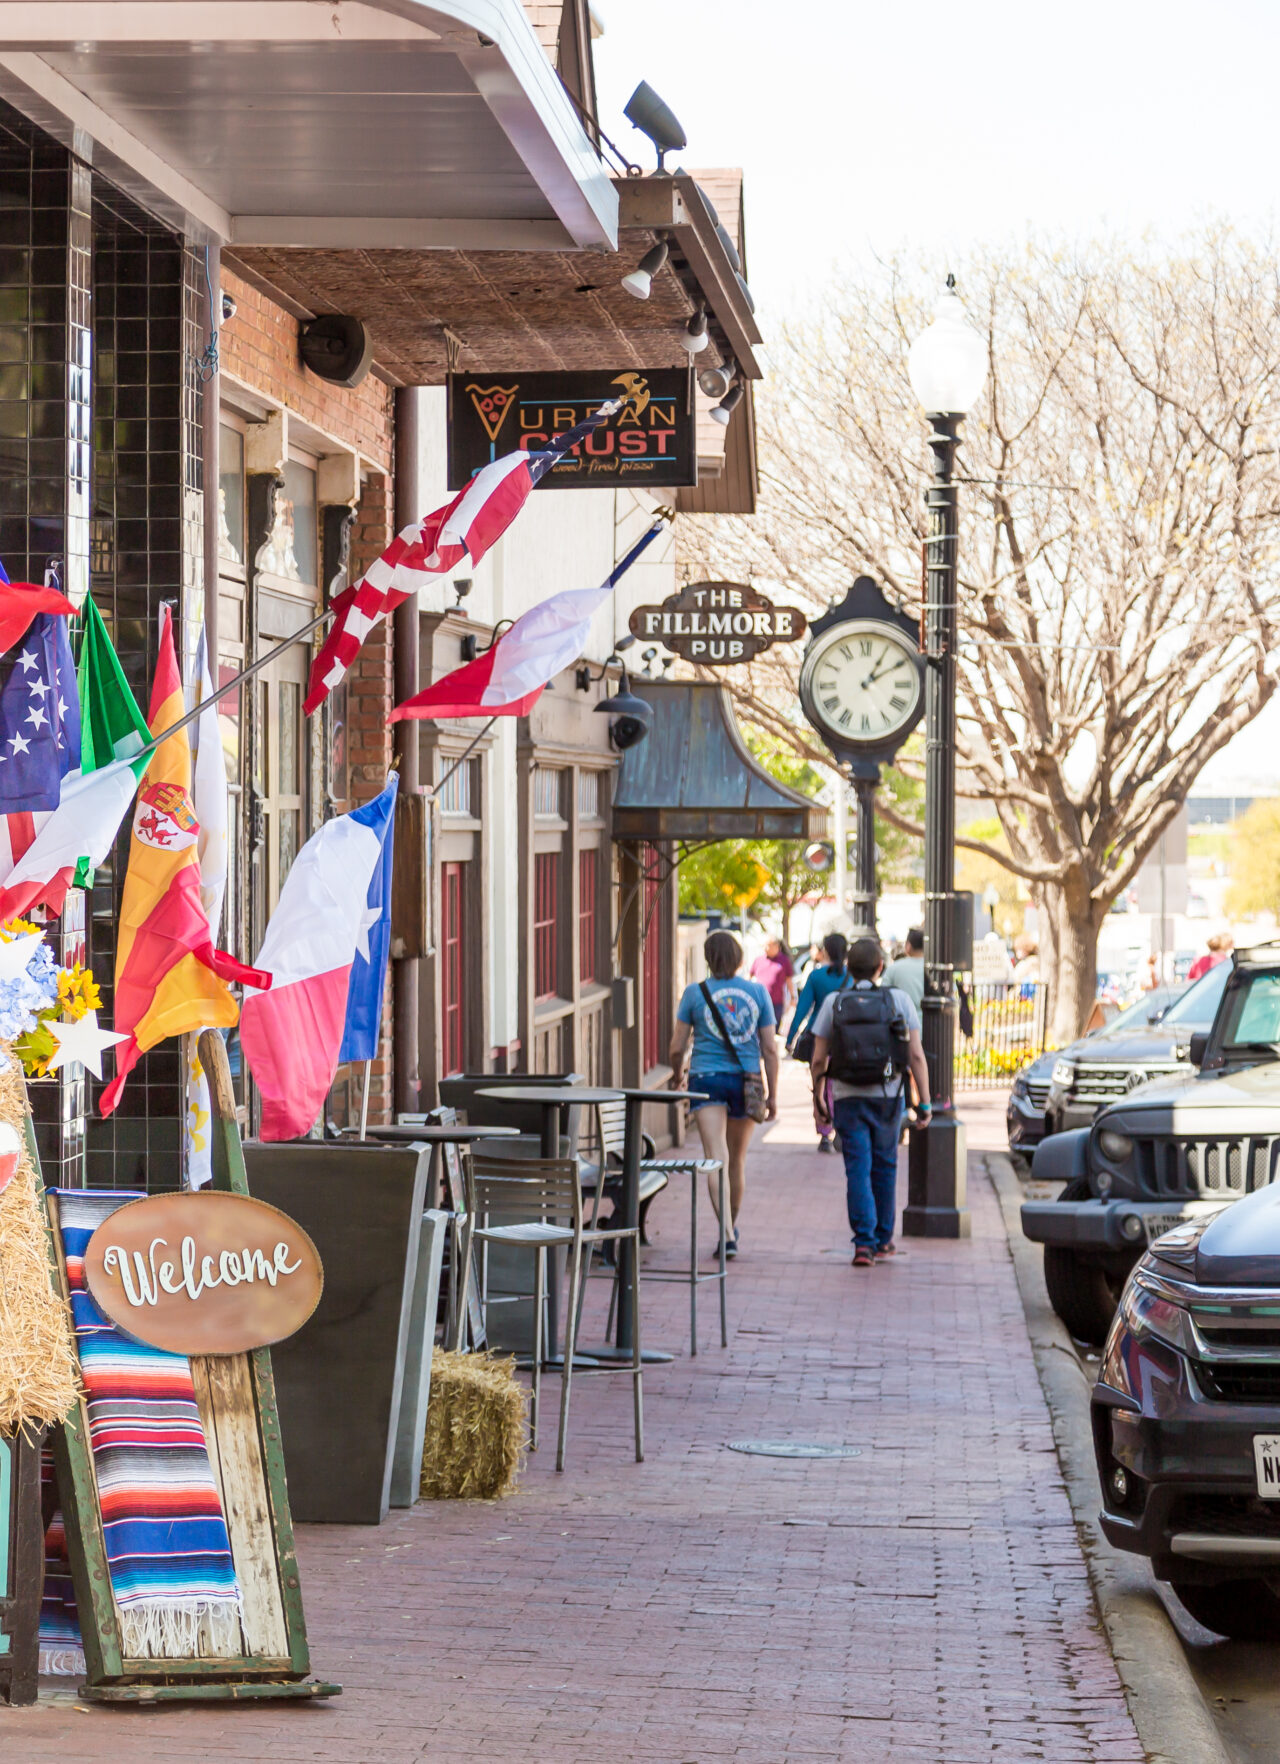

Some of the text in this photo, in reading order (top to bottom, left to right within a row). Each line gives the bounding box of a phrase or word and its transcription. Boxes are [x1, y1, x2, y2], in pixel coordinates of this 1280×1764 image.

[694, 589, 743, 608] THE
[645, 612, 793, 636] FILLMORE
[691, 640, 744, 660] PUB
[104, 1236, 302, 1307] Welcome
